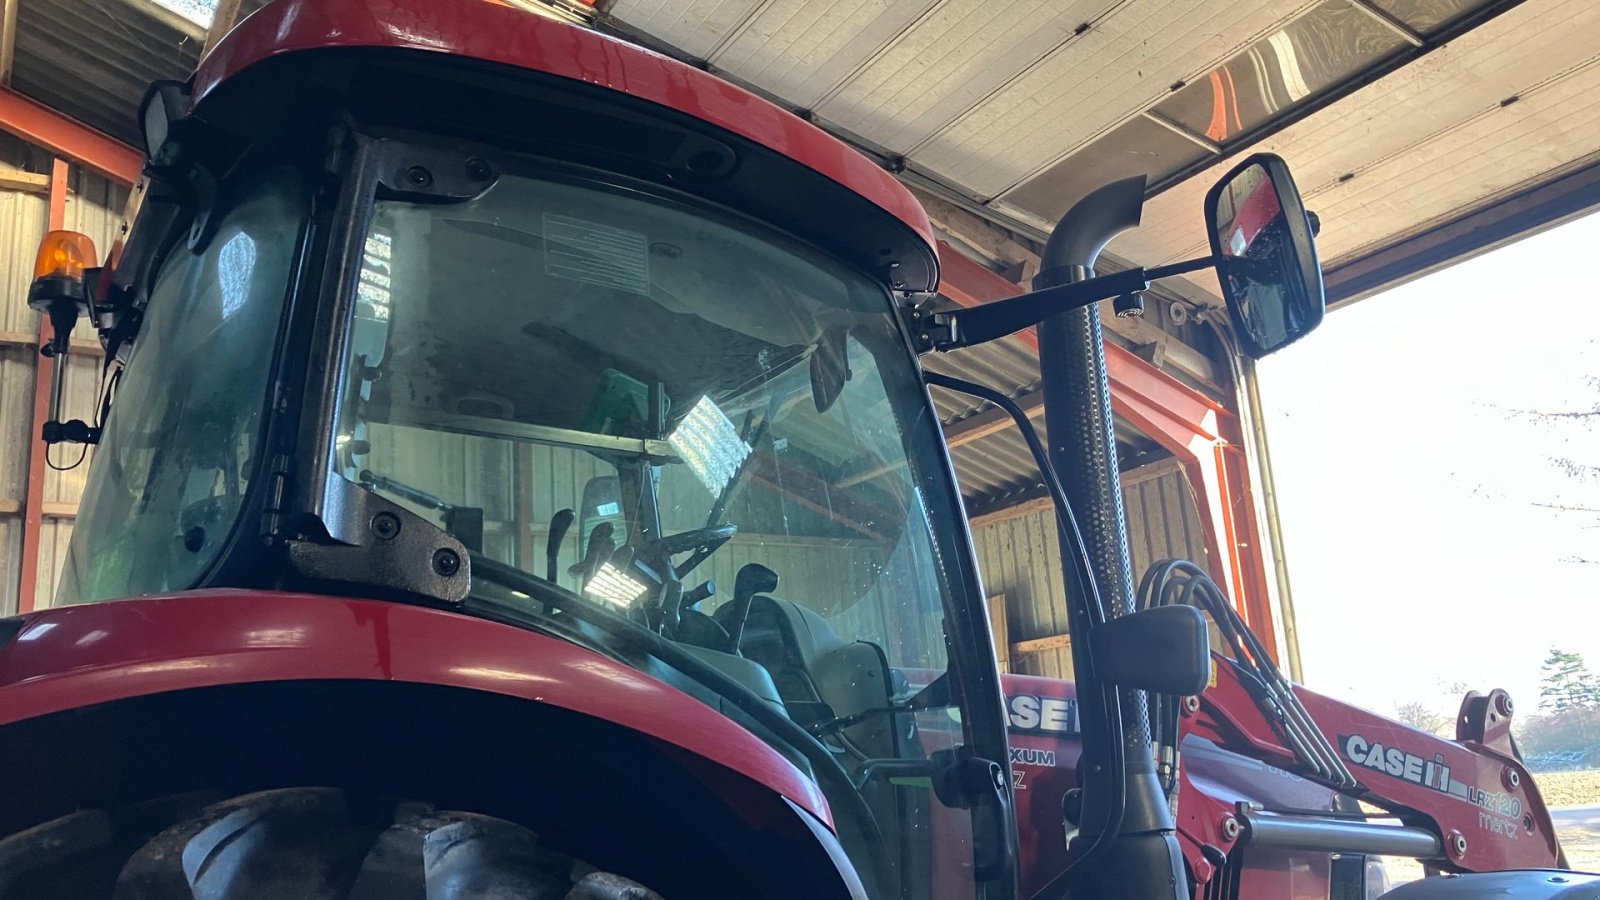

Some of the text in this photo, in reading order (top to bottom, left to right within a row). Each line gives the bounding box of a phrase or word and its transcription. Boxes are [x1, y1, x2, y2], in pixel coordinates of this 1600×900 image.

[1002, 694, 1068, 731] SE
[1346, 735, 1423, 783] CASE
[1468, 786, 1521, 819] LRZ120
